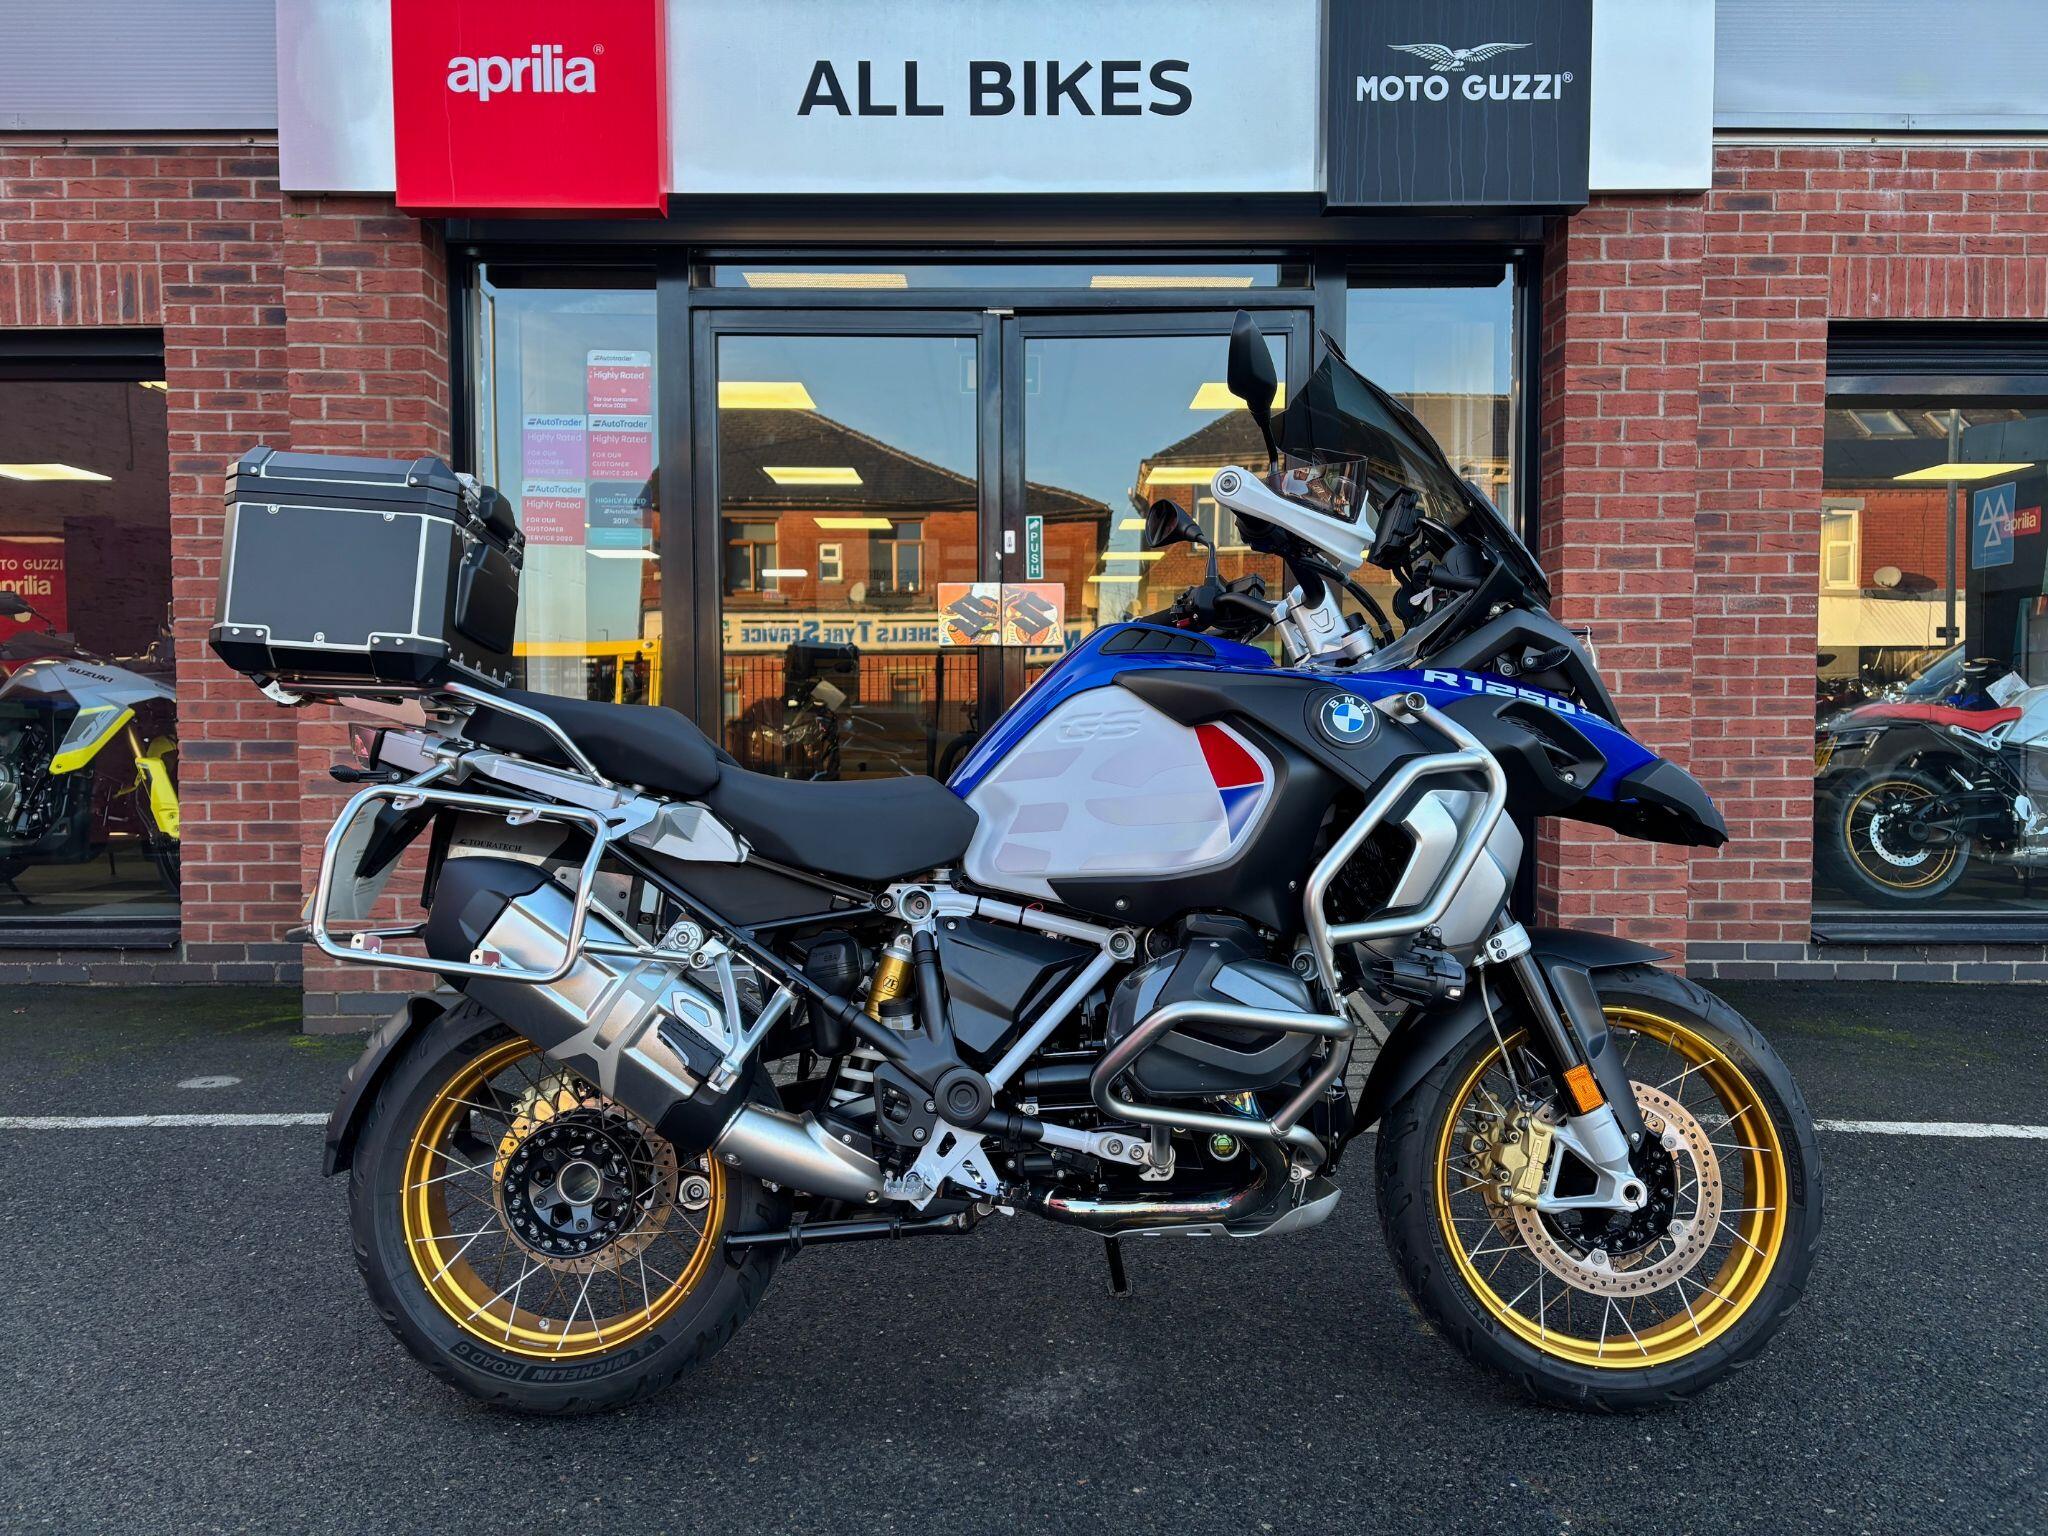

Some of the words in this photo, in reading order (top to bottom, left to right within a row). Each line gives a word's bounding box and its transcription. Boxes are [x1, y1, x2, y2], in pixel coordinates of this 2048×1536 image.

[798, 60, 944, 116] ALL
[970, 60, 1192, 116] BIKES
[1356, 74, 1450, 102] MOTO
[593, 371, 619, 380] Highly
[620, 371, 645, 380] Rated
[536, 417, 582, 427] AutoTrader
[601, 420, 648, 428] AutoTrader
[528, 431, 553, 442] Highly
[556, 432, 582, 442] Rated
[593, 434, 619, 444] Highly
[621, 434, 647, 443] Rated
[535, 485, 582, 494] AutoTrader
[526, 499, 553, 510] Highly
[555, 500, 581, 509] Rated
[595, 496, 622, 504] HIGHLY
[2003, 511, 2037, 534] aprilia
[1030, 532, 1040, 575] PUSH
[22, 558, 64, 571] GUZZI
[0, 574, 52, 597] prilia
[67, 666, 114, 684] SUZUKI
[1328, 696, 1371, 715] BMW
[1057, 709, 1145, 743] GS
[468, 838, 523, 853] TOURATECH
[471, 1351, 519, 1375] ROAD
[532, 1353, 634, 1380] MICHELIN
